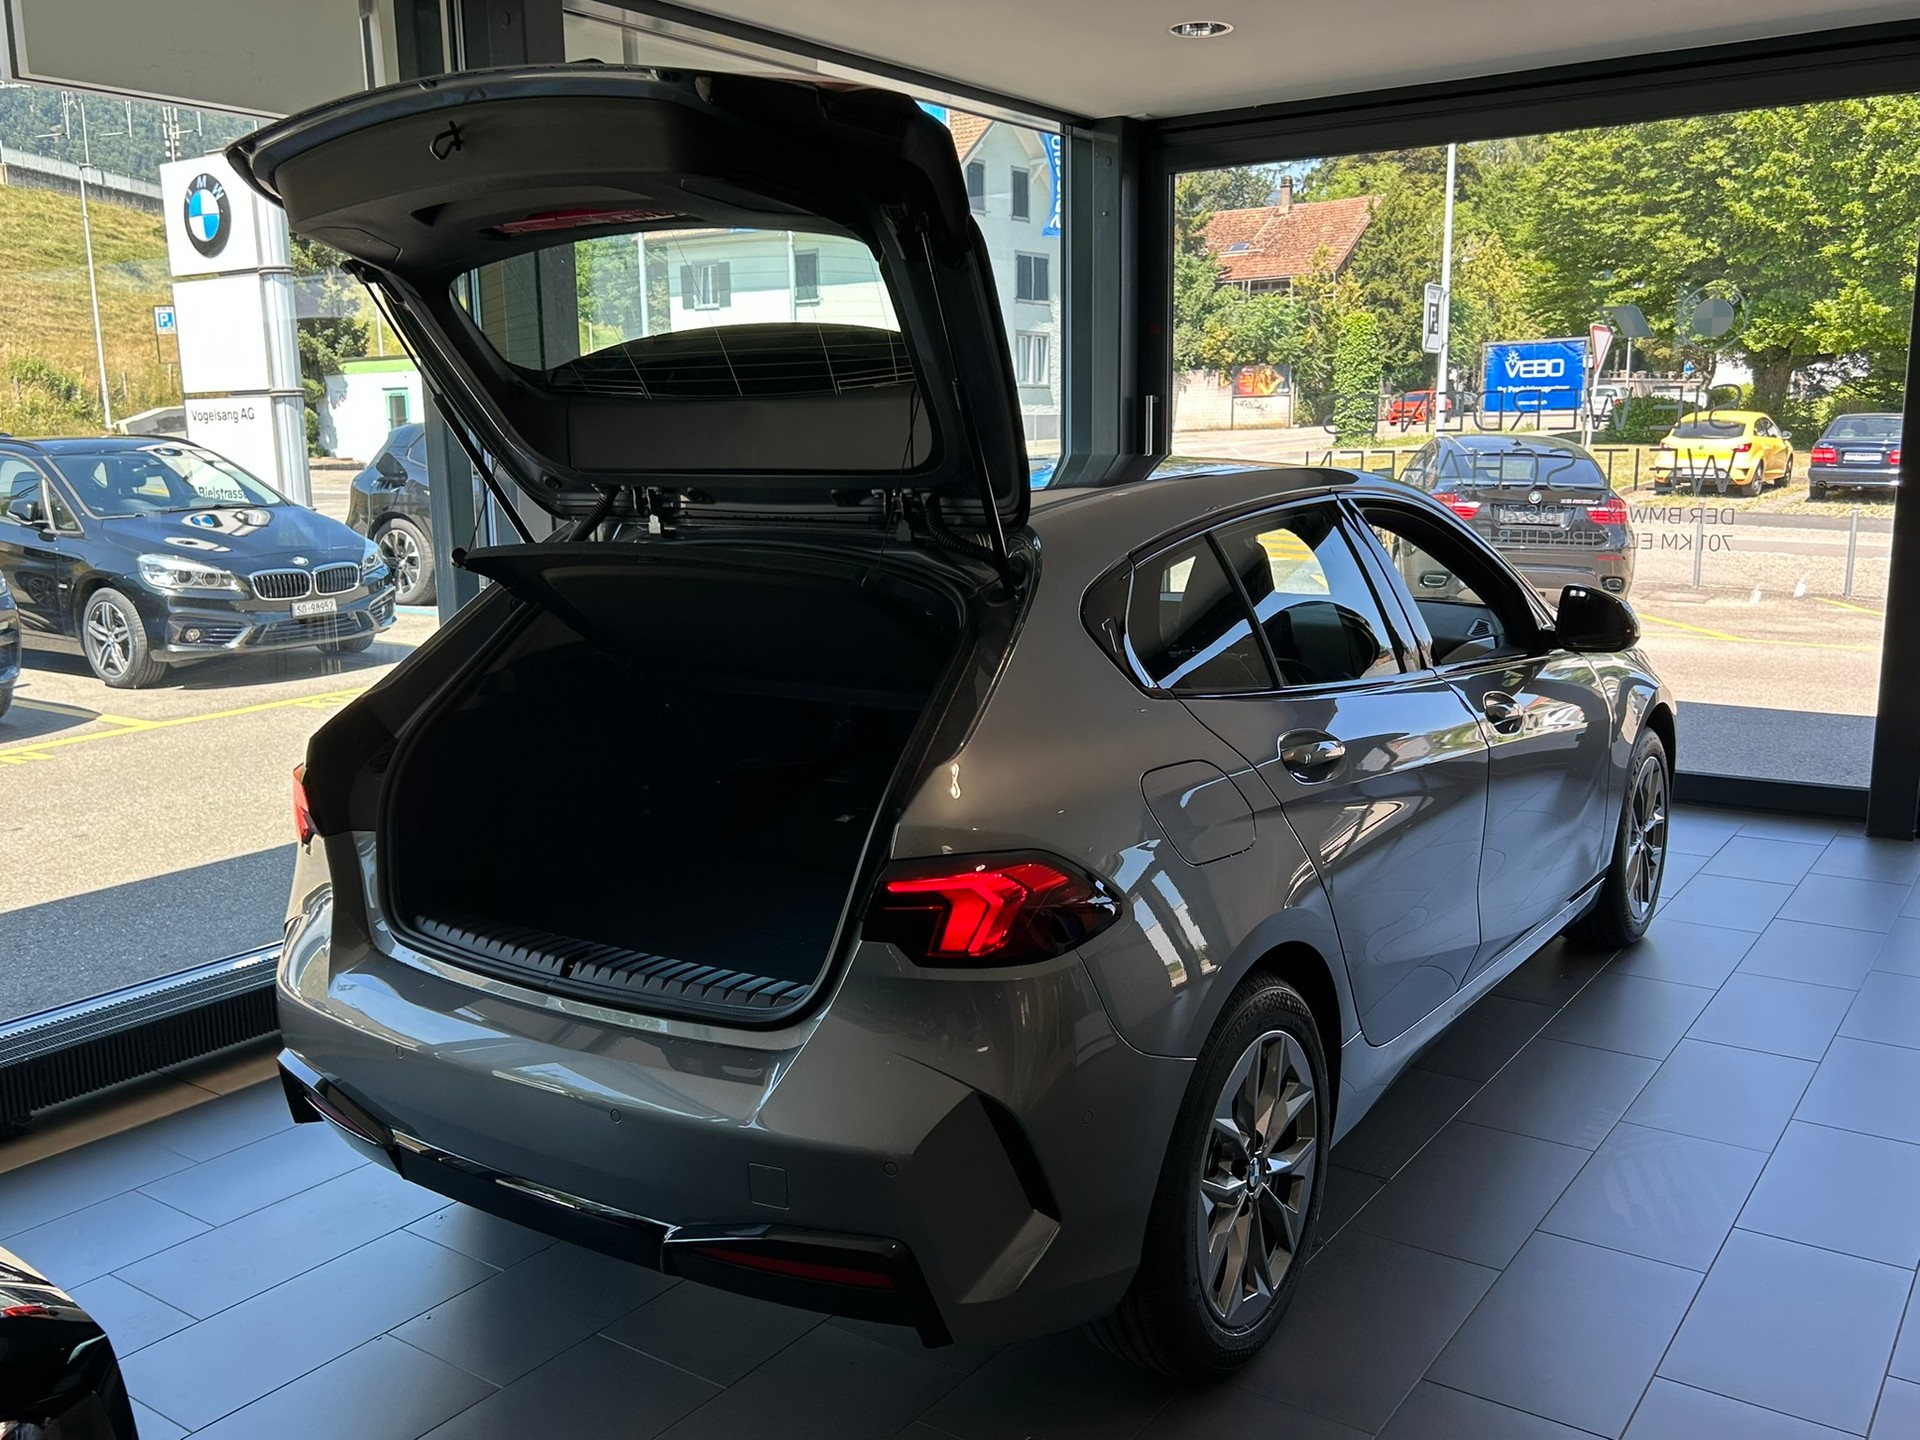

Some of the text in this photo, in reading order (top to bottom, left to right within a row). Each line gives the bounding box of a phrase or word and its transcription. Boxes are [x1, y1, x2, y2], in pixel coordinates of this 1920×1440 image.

[1504, 358, 1564, 378] VEBO
[191, 407, 255, 424] Vogelsang AG
